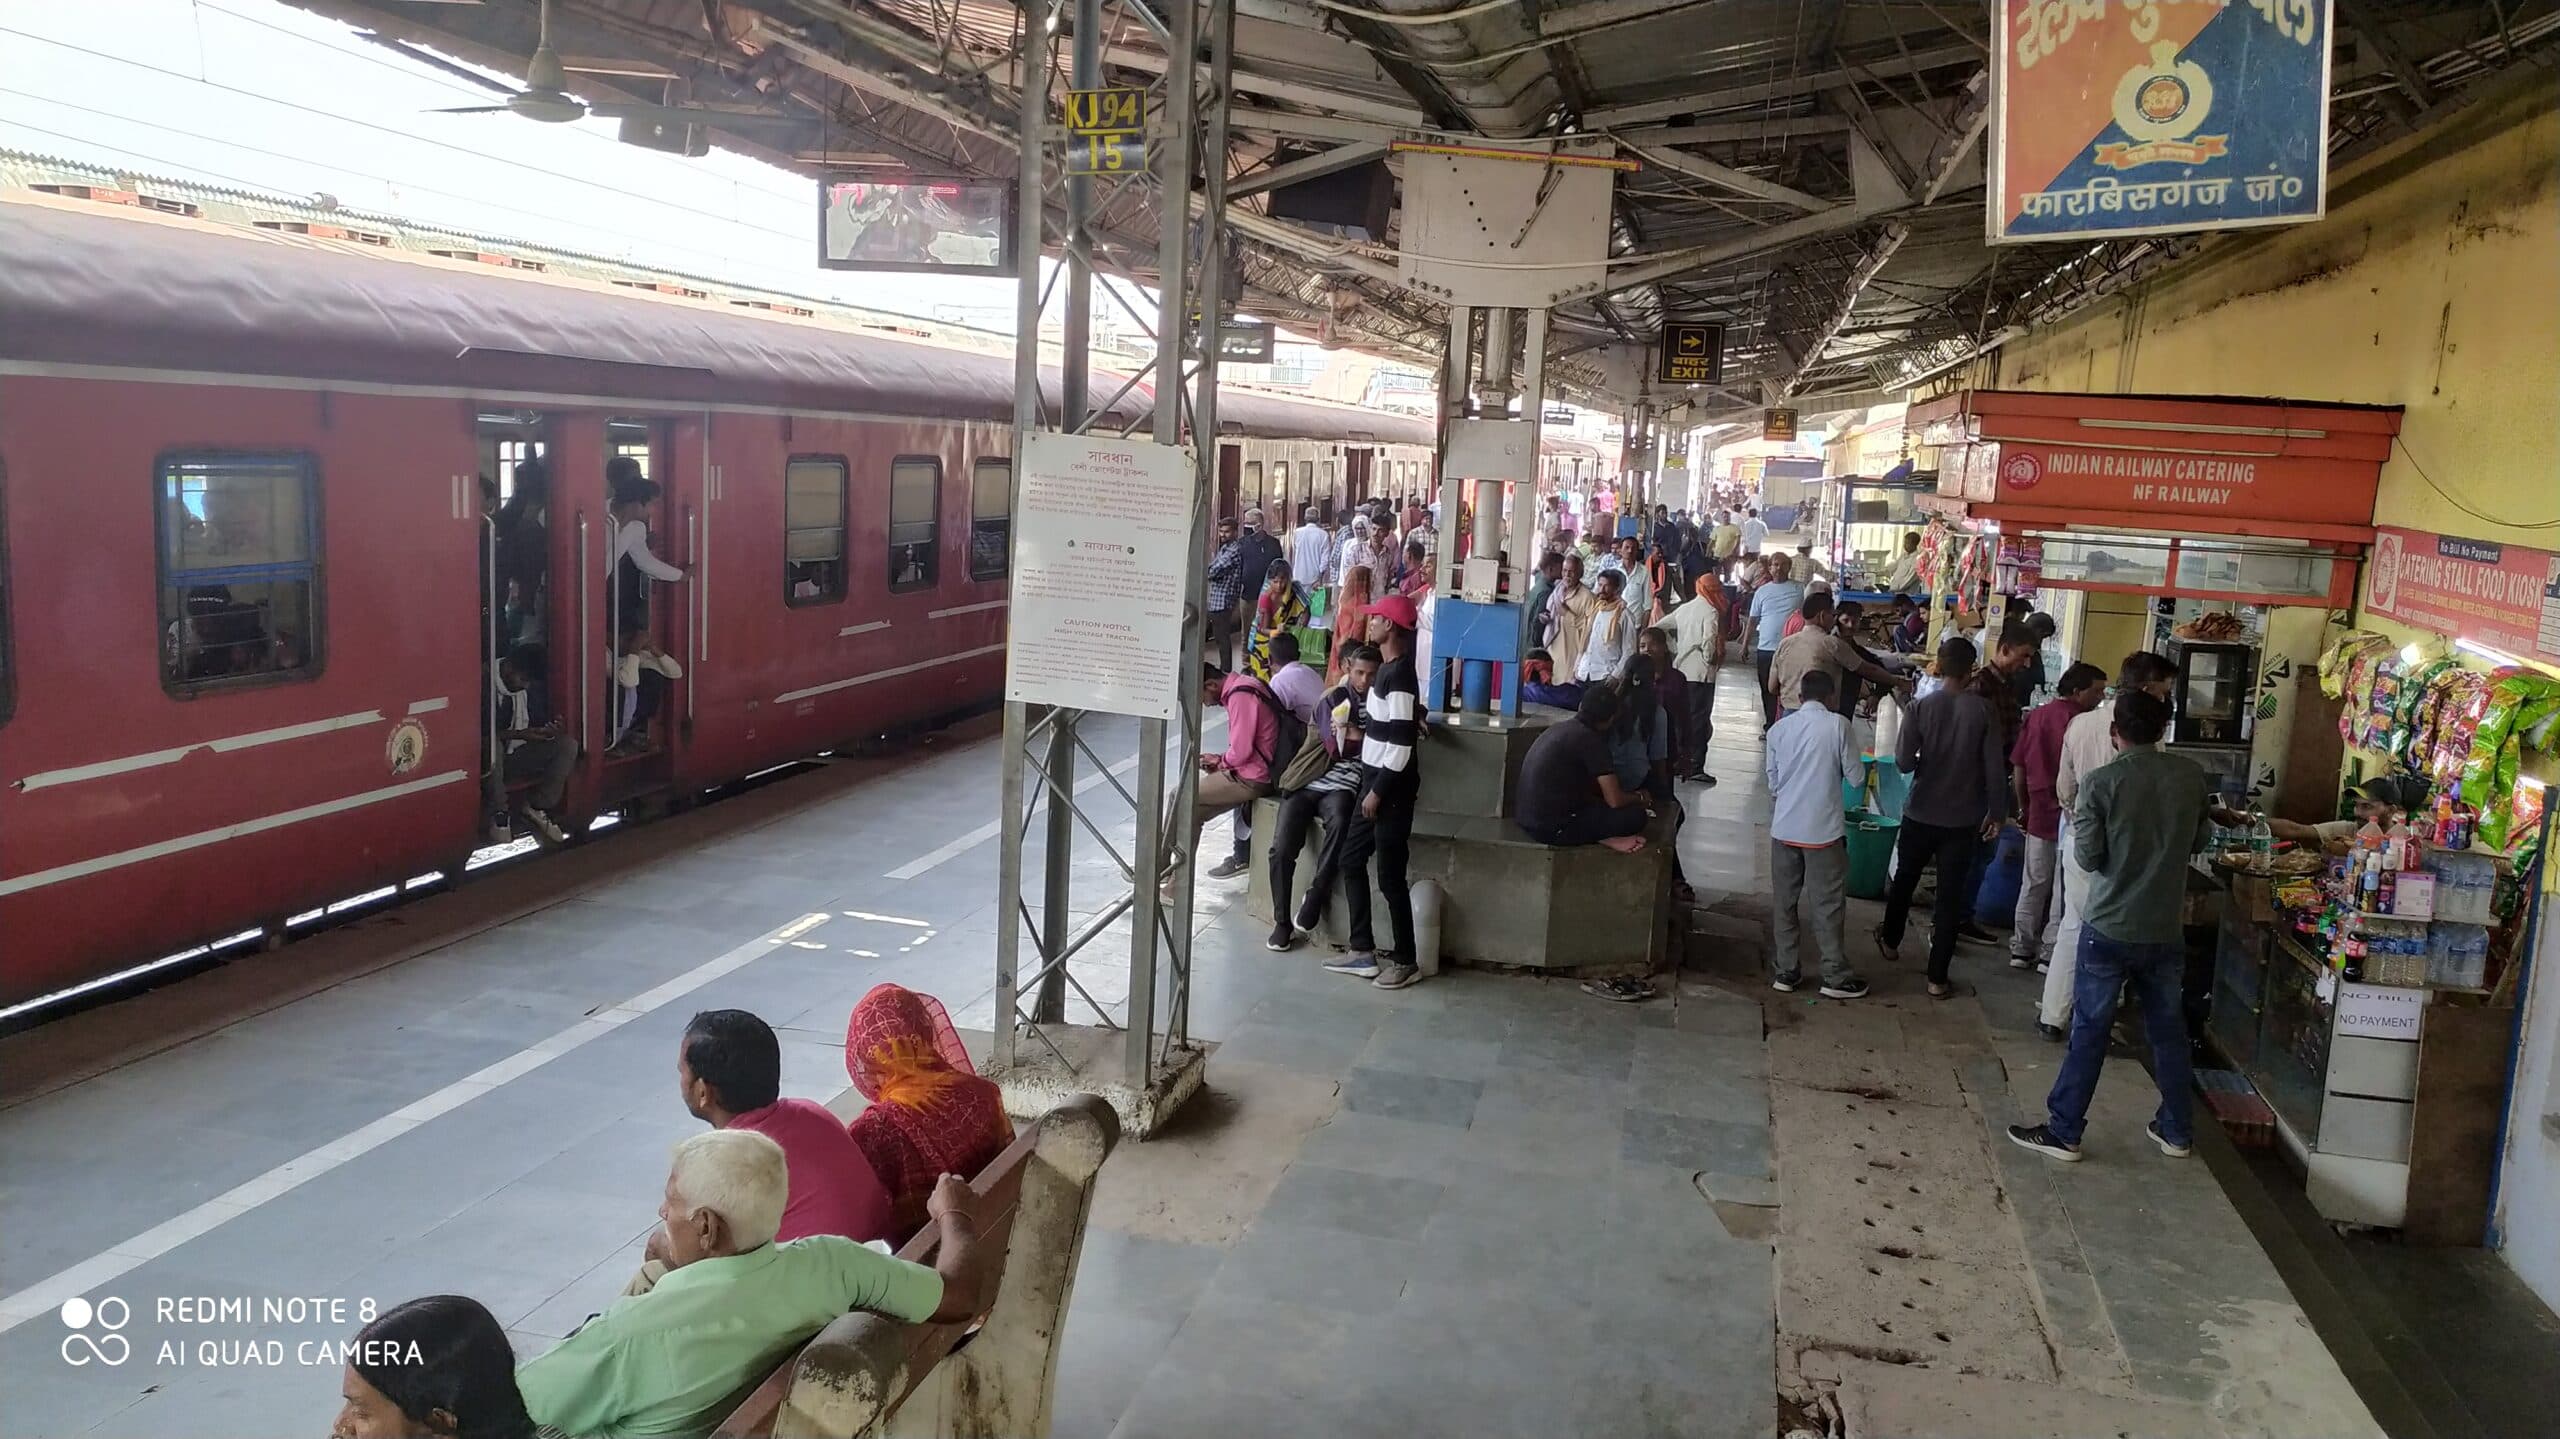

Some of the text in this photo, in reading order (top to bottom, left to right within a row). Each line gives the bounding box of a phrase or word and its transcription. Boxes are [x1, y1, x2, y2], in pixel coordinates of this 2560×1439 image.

[1066, 92, 1137, 128] KJ94
[1088, 133, 1122, 169] 15
[2019, 168, 2233, 218] फारबिसगंज
[1672, 356, 1710, 366] बाहर
[1671, 366, 1709, 378] EXIT
[2048, 453, 2100, 475] INDIAN
[2104, 456, 2174, 479] RAILWAY
[2175, 460, 2255, 484] CATERING
[2133, 484, 2231, 505] NF RAILWAY
[2399, 553, 2443, 588] CATERING
[2443, 561, 2473, 596] STALL
[2475, 566, 2506, 601] FOOD
[2507, 572, 2545, 609] KIOSK
[1064, 618, 1132, 632] CAUTION NOTICE
[1074, 630, 1104, 638] VOLTAGE
[1106, 633, 1140, 642] TRACTION
[2340, 1014, 2415, 1028] NO PAYMENT
